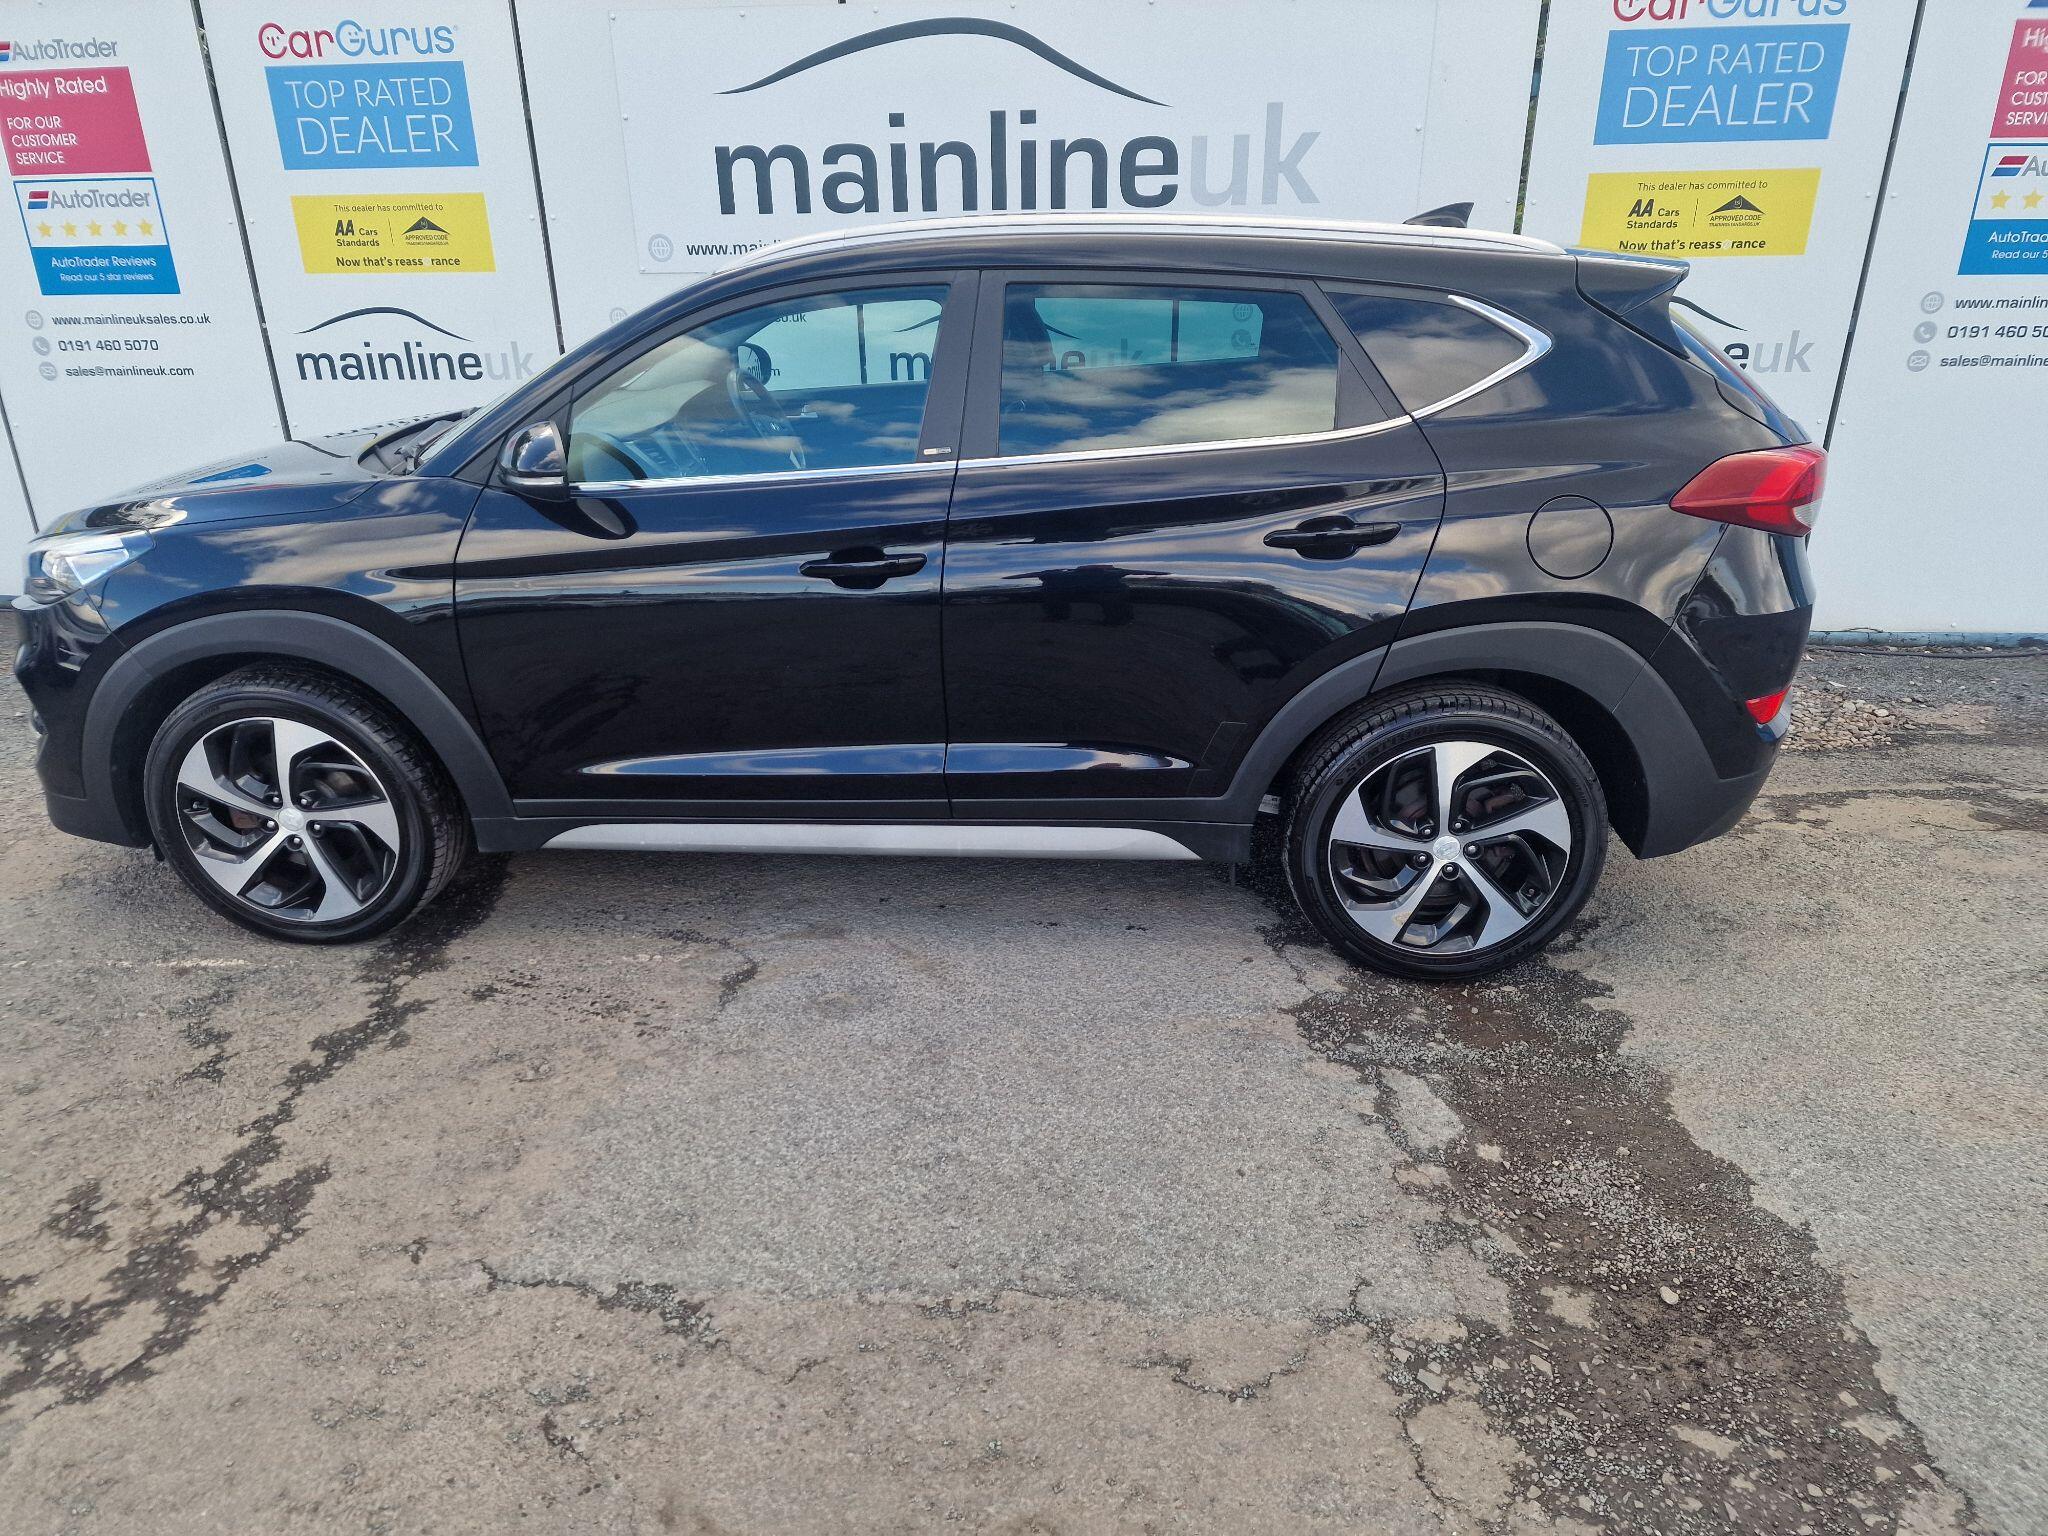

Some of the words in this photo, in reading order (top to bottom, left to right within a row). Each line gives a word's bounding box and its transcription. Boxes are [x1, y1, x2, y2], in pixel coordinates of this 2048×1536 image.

[258, 19, 456, 59] CarGurus
[12, 37, 118, 61] AutoTrader
[1626, 44, 1698, 77] TOP
[1706, 41, 1825, 75] RATED
[2015, 71, 2048, 85] FOR
[0, 78, 50, 101] Highly
[54, 75, 108, 94] Rated
[284, 79, 345, 109] TOP
[354, 77, 451, 107] RATED
[1622, 81, 1815, 128] DEALER
[7, 117, 32, 130] FOR
[35, 115, 62, 129] OUR
[11, 132, 78, 147] CUSTOMER
[296, 113, 460, 155] DEALER
[16, 151, 65, 165] SERVICE
[714, 102, 1321, 215] mainlineuk
[1638, 183, 1655, 191] This
[1660, 182, 1686, 191] dealer
[1689, 181, 1704, 190] has
[1707, 180, 1756, 190] committed
[1759, 180, 1768, 189] to
[50, 188, 150, 209] AutoTrader
[334, 204, 351, 213] This
[352, 204, 375, 212] dealer
[377, 203, 391, 212] has
[392, 202, 433, 212] committed
[435, 203, 444, 211] to
[1627, 198, 1655, 217] AA
[1657, 208, 1680, 217] Cars
[335, 219, 355, 236] AA
[359, 227, 378, 236] Cars
[1626, 219, 1678, 229] Standards
[336, 238, 380, 247] Standards
[1619, 240, 1649, 250] Now
[1651, 239, 1686, 250] that's
[1992, 249, 2020, 259] Read
[2022, 251, 2040, 259] our
[51, 256, 110, 268] AutoTrader
[111, 255, 157, 267] Reviews
[336, 257, 361, 267] Now
[363, 256, 393, 267] that's
[60, 272, 83, 281] Read
[106, 272, 121, 281] star
[123, 272, 154, 281] reviews
[52, 312, 212, 325] www.mainlineuksales.co.uk
[1947, 325, 1990, 338] 0191
[1994, 325, 2028, 338] 460
[58, 339, 92, 352] 0191
[96, 339, 122, 351] 460
[124, 339, 159, 351] 5070
[295, 341, 535, 381] mainlineuk
[65, 365, 195, 377] sales@mainlineuk.com
